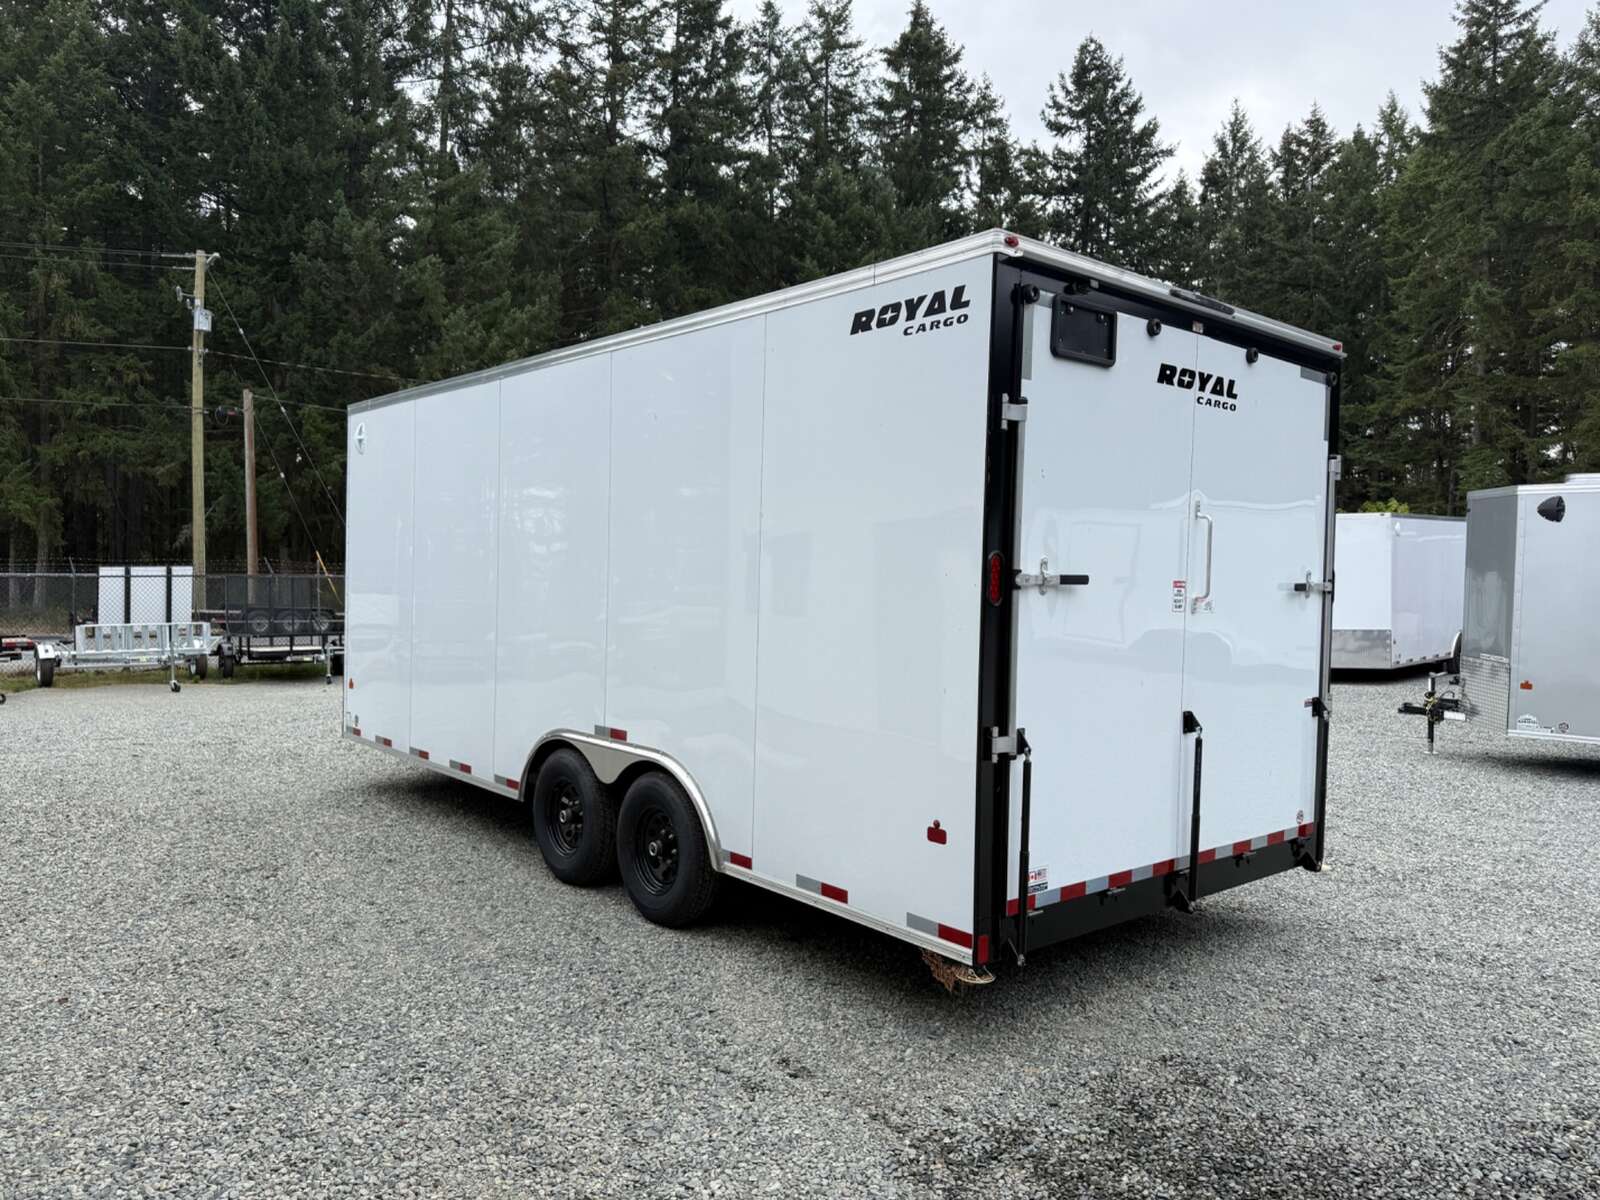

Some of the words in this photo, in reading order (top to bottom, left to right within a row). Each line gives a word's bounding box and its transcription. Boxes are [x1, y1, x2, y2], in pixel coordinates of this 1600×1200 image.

[850, 284, 971, 336] ROYAL
[902, 313, 969, 337] CARGO
[1156, 362, 1239, 400] ROYAL
[1196, 395, 1237, 412] CARGO
